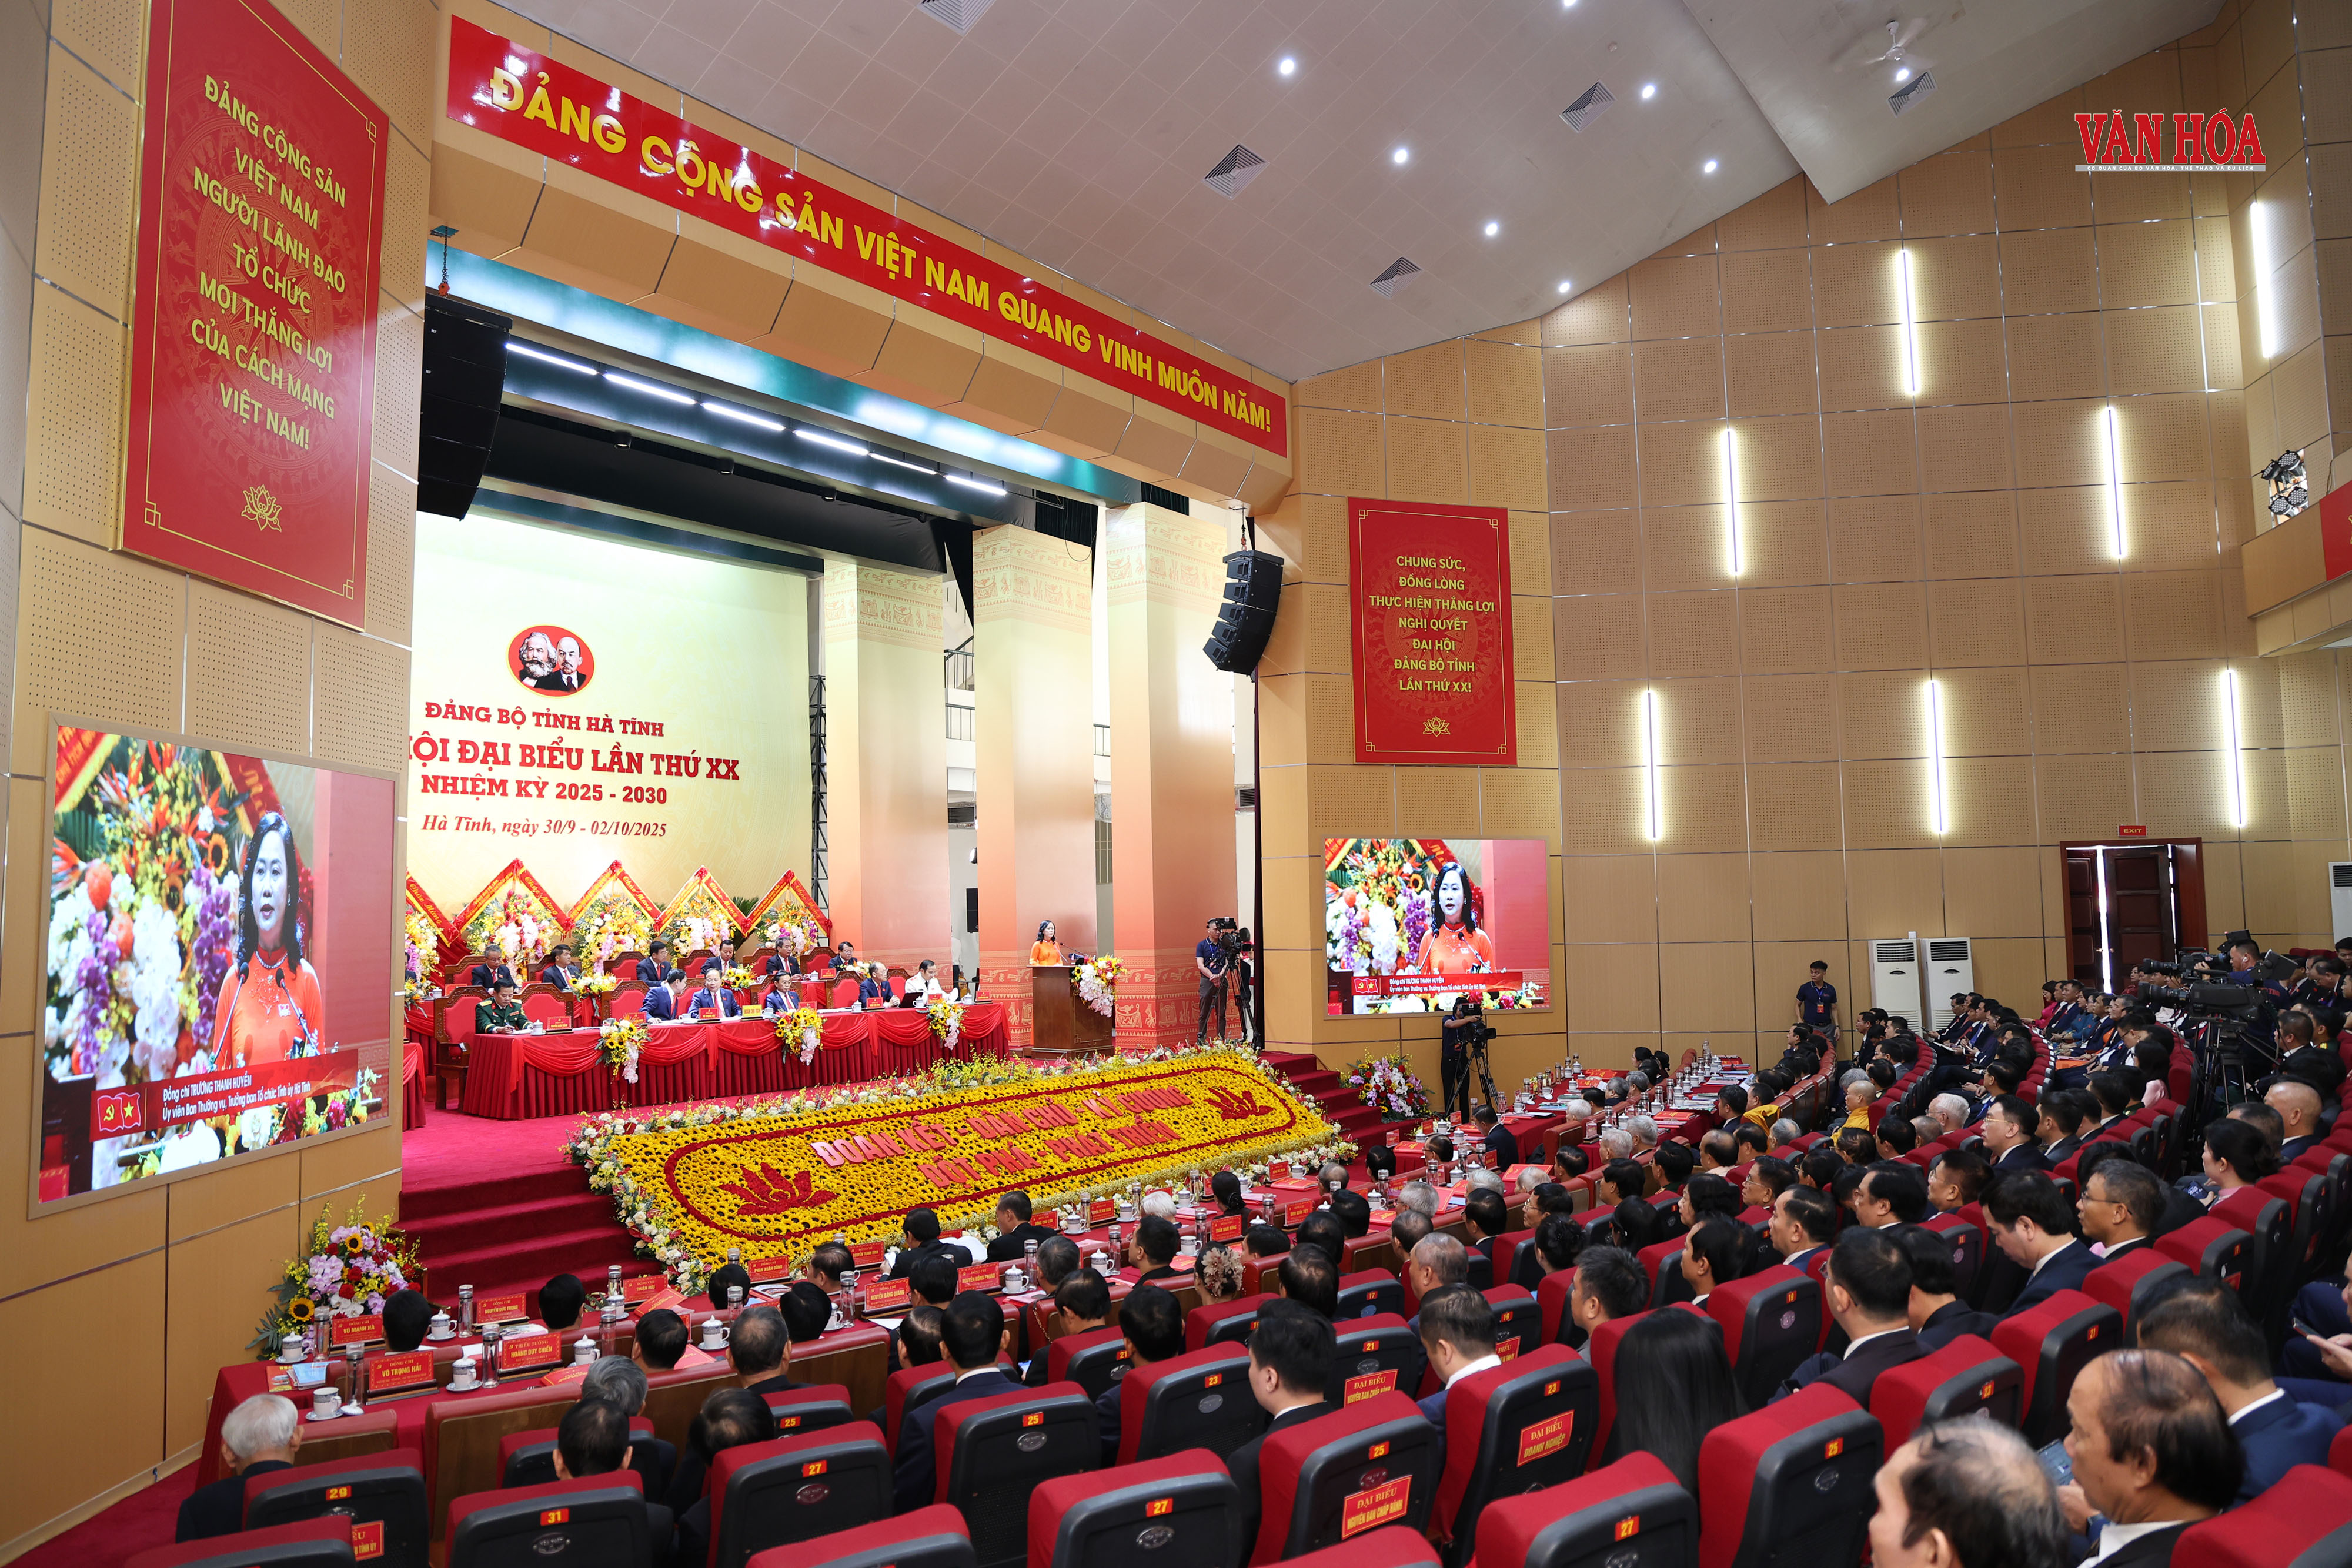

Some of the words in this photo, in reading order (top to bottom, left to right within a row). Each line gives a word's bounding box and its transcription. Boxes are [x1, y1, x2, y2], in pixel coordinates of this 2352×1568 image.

[205, 73, 259, 137] ĐẢNG
[263, 123, 312, 178] CỘNG
[315, 163, 346, 208] SẢN
[235, 146, 276, 197] VIỆT
[280, 189, 319, 230] NAM
[193, 167, 260, 232] NGƯỜI
[263, 211, 310, 265] LÃNH
[313, 253, 346, 295] ĐẠO
[489, 65, 627, 155] ĐẢNG
[641, 135, 764, 213] CỘNG
[774, 190, 843, 249] SẢN
[854, 224, 916, 280] VIỆT
[924, 255, 990, 312] NAM
[998, 290, 1091, 353] QUANG
[1098, 333, 1153, 382] VINH
[1158, 359, 1218, 411] MUÔN
[1222, 390, 1271, 433] NĂM!
[233, 242, 259, 279] TỔ
[262, 263, 310, 315] CHỨC
[199, 270, 239, 320] MỌI
[243, 303, 304, 357] THẮNG
[307, 338, 333, 374] LỢI
[191, 319, 230, 357] CỦA
[235, 341, 284, 392] CÁCH
[288, 377, 335, 419] MẠNG
[219, 380, 262, 427] VIỆT
[266, 407, 310, 450] NAM!
[1396, 556, 1436, 568] CHUNG
[1439, 556, 1466, 571] SỨC,
[1399, 573, 1432, 588] ĐỒNG
[1434, 576, 1465, 590] LÒNG
[1369, 596, 1401, 609] THỰC
[1404, 597, 1432, 610] HIỆN
[1435, 596, 1474, 611] THẮNG
[1476, 600, 1494, 613] LỢI
[1399, 618, 1428, 631] NGHỊ
[1430, 617, 1468, 632] QUYẾT
[1412, 639, 1432, 651] ĐẠI
[1435, 637, 1455, 652] HỘI
[1394, 656, 1426, 670] ĐẢNG
[1429, 658, 1445, 673] BỘ
[1447, 657, 1475, 672] TỈNH
[1399, 677, 1422, 691] LẦN
[1425, 678, 1451, 691] THỨ
[1452, 681, 1472, 693] XX!
[425, 699, 492, 721] ĐẢNG
[497, 707, 526, 730] BỘ
[532, 708, 581, 731] TỈNH
[586, 714, 614, 733] HÀ
[619, 717, 664, 737] TĨNH
[458, 740, 511, 771] ĐẠI
[519, 736, 583, 771] BIỂU
[591, 743, 643, 774] LẦN
[650, 750, 701, 777] THỨ
[706, 758, 739, 780] XX
[421, 773, 509, 801] NHIỆM
[516, 776, 549, 798] KỲ
[556, 783, 603, 801] 2025
[622, 786, 667, 804] 2030
[422, 815, 447, 831] Hà
[455, 816, 496, 834] Tĩnh,
[502, 820, 539, 837] ngày
[545, 819, 576, 835] 30/9
[590, 820, 667, 837] 02/10/2025
[163, 1085, 179, 1102] Đồng
[181, 1085, 189, 1098] chí
[214, 1079, 232, 1092] THANH
[163, 1102, 171, 1121] Ủy
[172, 1106, 185, 1119] viên
[186, 1102, 196, 1115] Ban
[198, 1100, 218, 1113] Thường
[219, 1101, 227, 1112] vụ,
[228, 1094, 246, 1108] Trưởng
[246, 1092, 256, 1104] ban
[257, 1088, 263, 1102] Tổ
[263, 1089, 276, 1100] chức
[288, 1083, 293, 1097] ủy
[294, 1083, 301, 1094] Hà
[810, 1130, 906, 1168] ĐOÀN
[898, 1116, 958, 1153] KẾT
[1025, 1097, 1078, 1129] CHỦ
[1118, 1085, 1194, 1114] CƯƠNG
[917, 1155, 981, 1189] ĐỘT
[979, 1141, 1042, 1177] PHÁ
[1047, 1131, 1115, 1162] PHÁT
[1108, 1117, 1181, 1150] TRIỂN
[1788, 1293, 1795, 1301] 19
[1498, 1343, 1512, 1353] BIỂU
[391, 1367, 410, 1376] TRỌNG
[1208, 1376, 1218, 1386] 23
[1354, 1380, 1367, 1389] ĐẠI
[1369, 1374, 1386, 1386] BIỂU
[1548, 1383, 1557, 1395] 23
[785, 1418, 796, 1427] 25
[1027, 1415, 1039, 1426] 25
[1531, 1429, 1545, 1441] ĐẠI
[1546, 1419, 1563, 1433] BIỂU
[1373, 1445, 1385, 1457] 25
[1524, 1442, 1544, 1458] DOANH
[1828, 1442, 1839, 1456] 25
[808, 1463, 822, 1475] 27
[329, 1487, 348, 1499] 29
[1357, 1496, 1373, 1509] ĐẠI
[1375, 1485, 1397, 1503] BIỂU
[1154, 1500, 1168, 1515] 27
[547, 1511, 562, 1524] 31
[1621, 1520, 1635, 1537] 27
